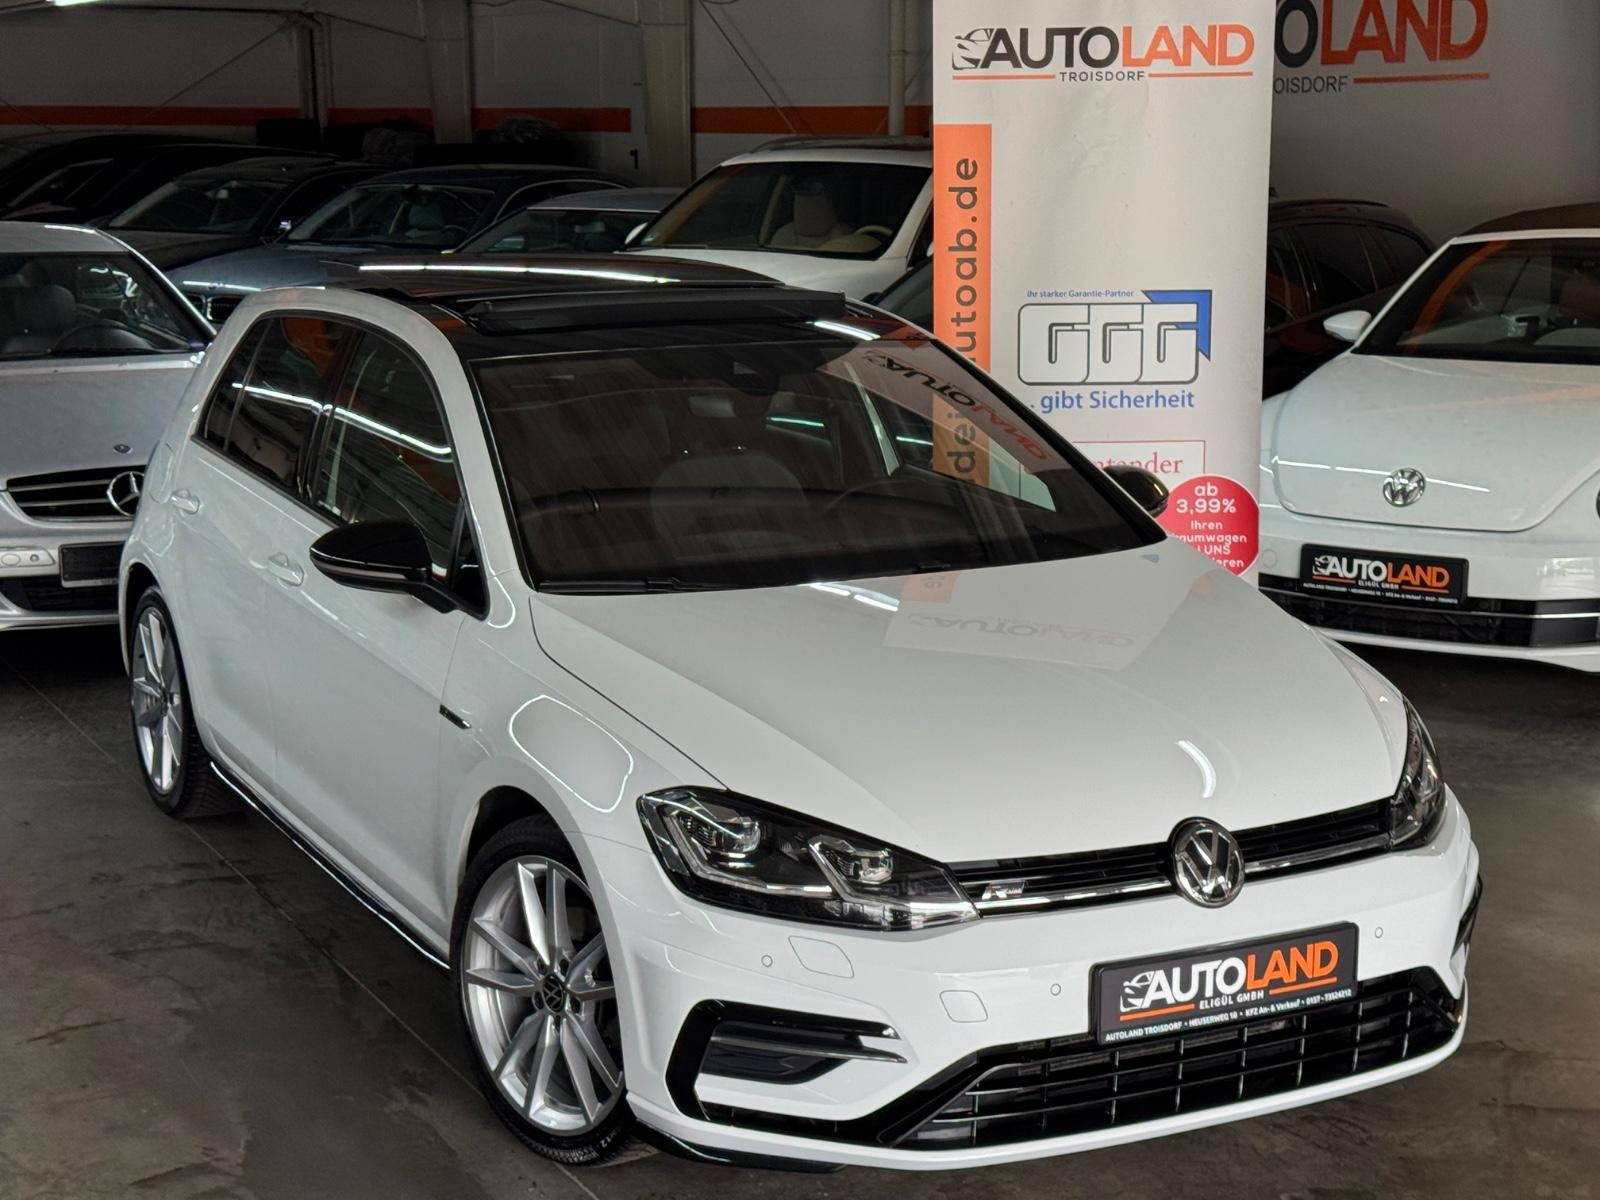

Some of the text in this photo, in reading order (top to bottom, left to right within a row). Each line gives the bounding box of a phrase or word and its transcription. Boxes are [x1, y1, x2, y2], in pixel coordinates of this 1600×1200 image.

[1274, 0, 1489, 68] OLAND
[979, 24, 1255, 69] AUTOLAND
[1059, 71, 1146, 83] TROISDORF
[1272, 75, 1349, 94] OISDORF
[1026, 289, 1134, 298] Ihr starker Garantie-Partner
[1040, 389, 1195, 413] gibt Sicherheit
[1194, 482, 1219, 497] ab
[1190, 519, 1224, 530] Ihren
[1174, 533, 1248, 546] aumwagen
[1203, 544, 1232, 555] UNS
[1326, 556, 1450, 588] AUTOLAND
[1142, 940, 1339, 1009] AUTOLAND
[1199, 989, 1265, 1010] ELIGÜL GMBH
[1105, 1027, 1144, 1042] AUTOLAND
[1145, 1021, 1183, 1036] TROISDORF
[1276, 998, 1300, 1011] Verkauf
